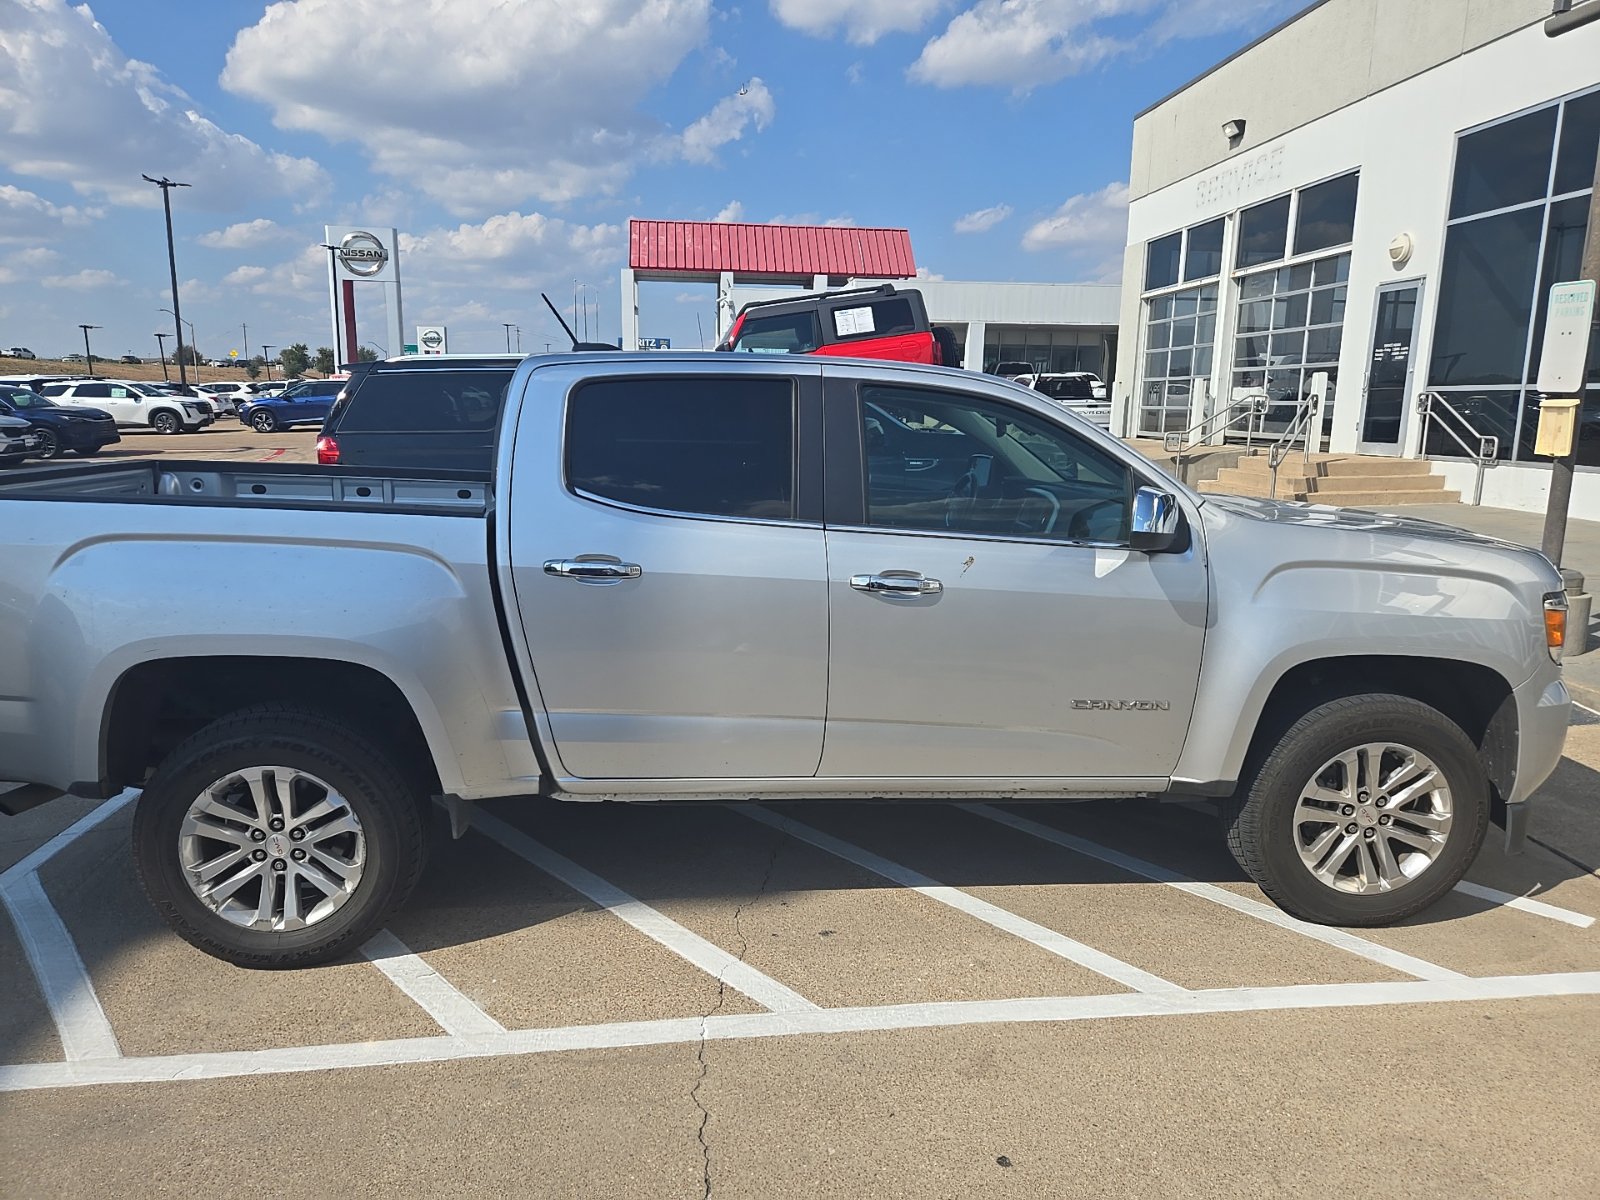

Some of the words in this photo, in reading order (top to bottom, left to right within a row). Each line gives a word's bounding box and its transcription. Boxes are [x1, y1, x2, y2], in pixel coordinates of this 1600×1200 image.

[340, 248, 383, 258] NISSAN
[1554, 291, 1589, 304] RESERVED
[1071, 699, 1170, 711] CANYON
